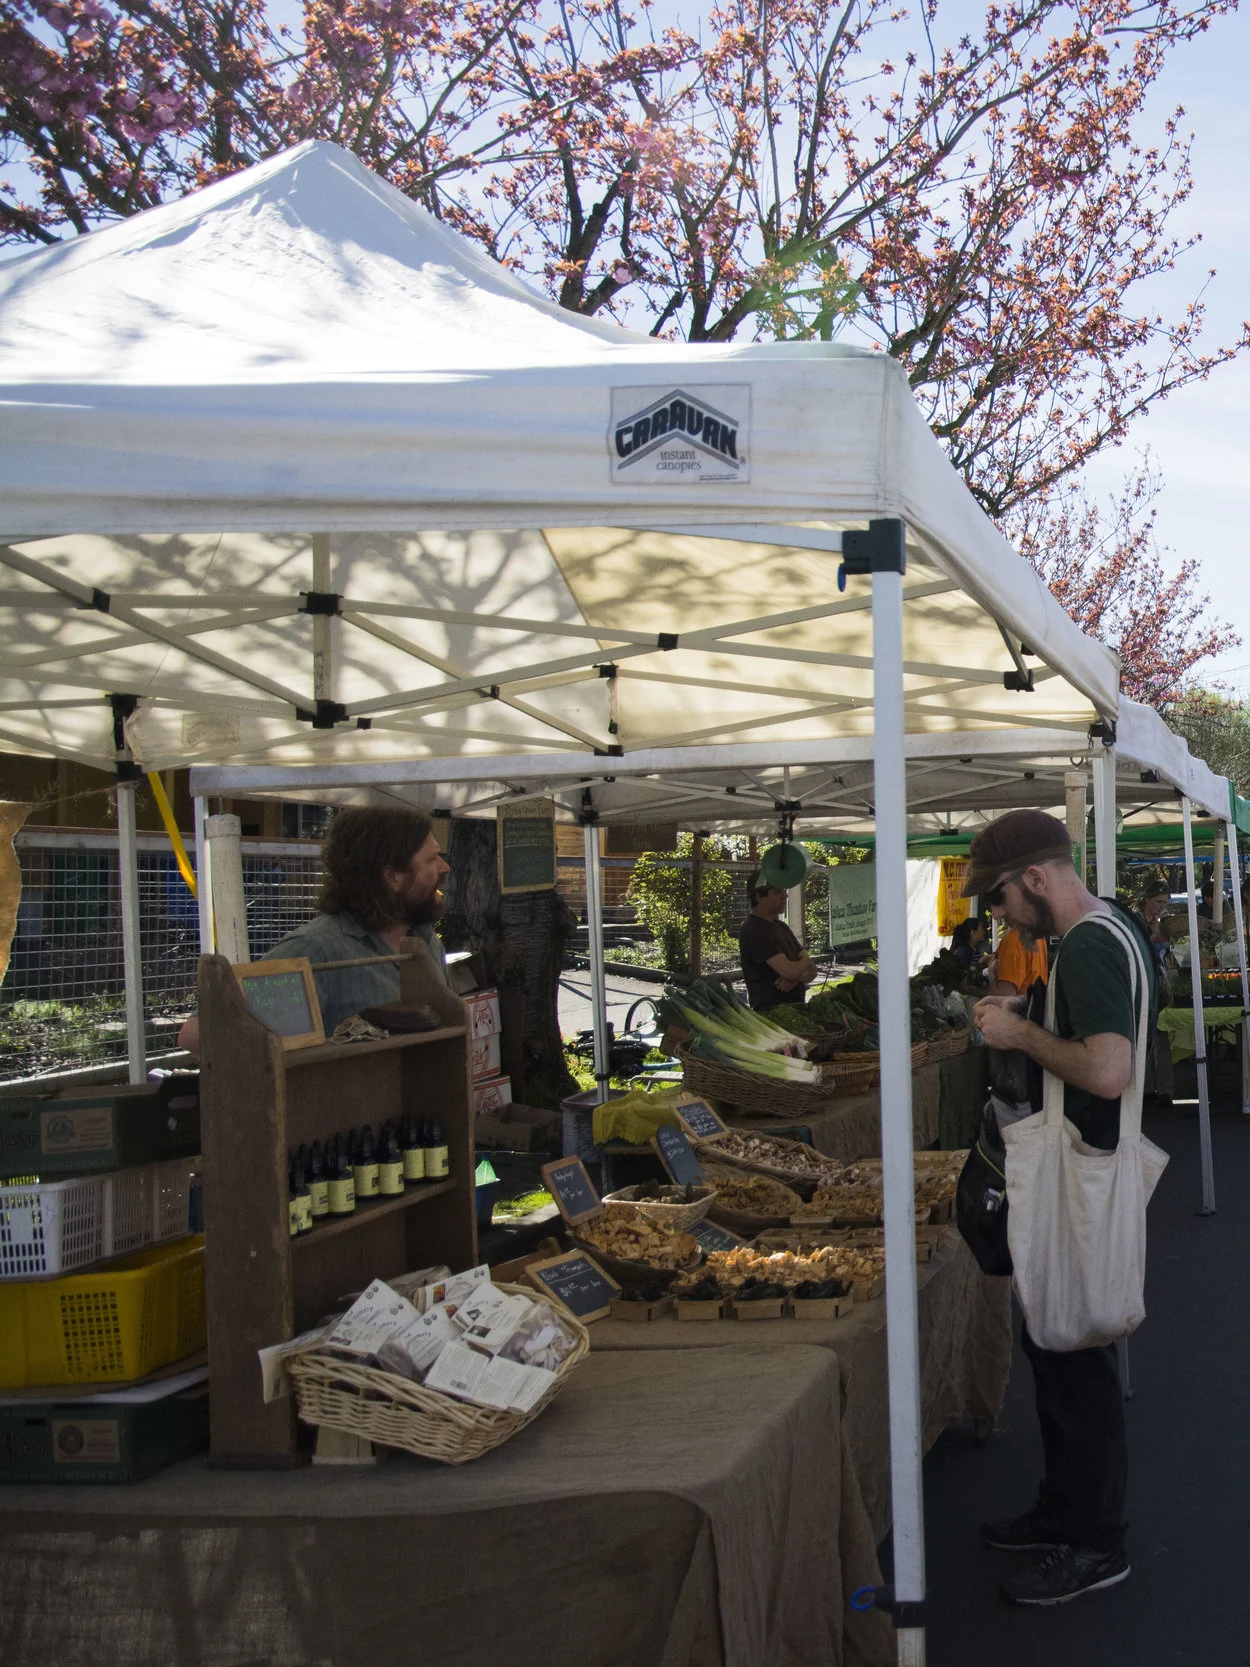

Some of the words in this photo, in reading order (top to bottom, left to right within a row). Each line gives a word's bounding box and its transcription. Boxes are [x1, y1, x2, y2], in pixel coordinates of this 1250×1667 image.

[615, 398, 738, 460] CARAVAN
[660, 450, 696, 461] instant
[656, 460, 702, 473] canopies
